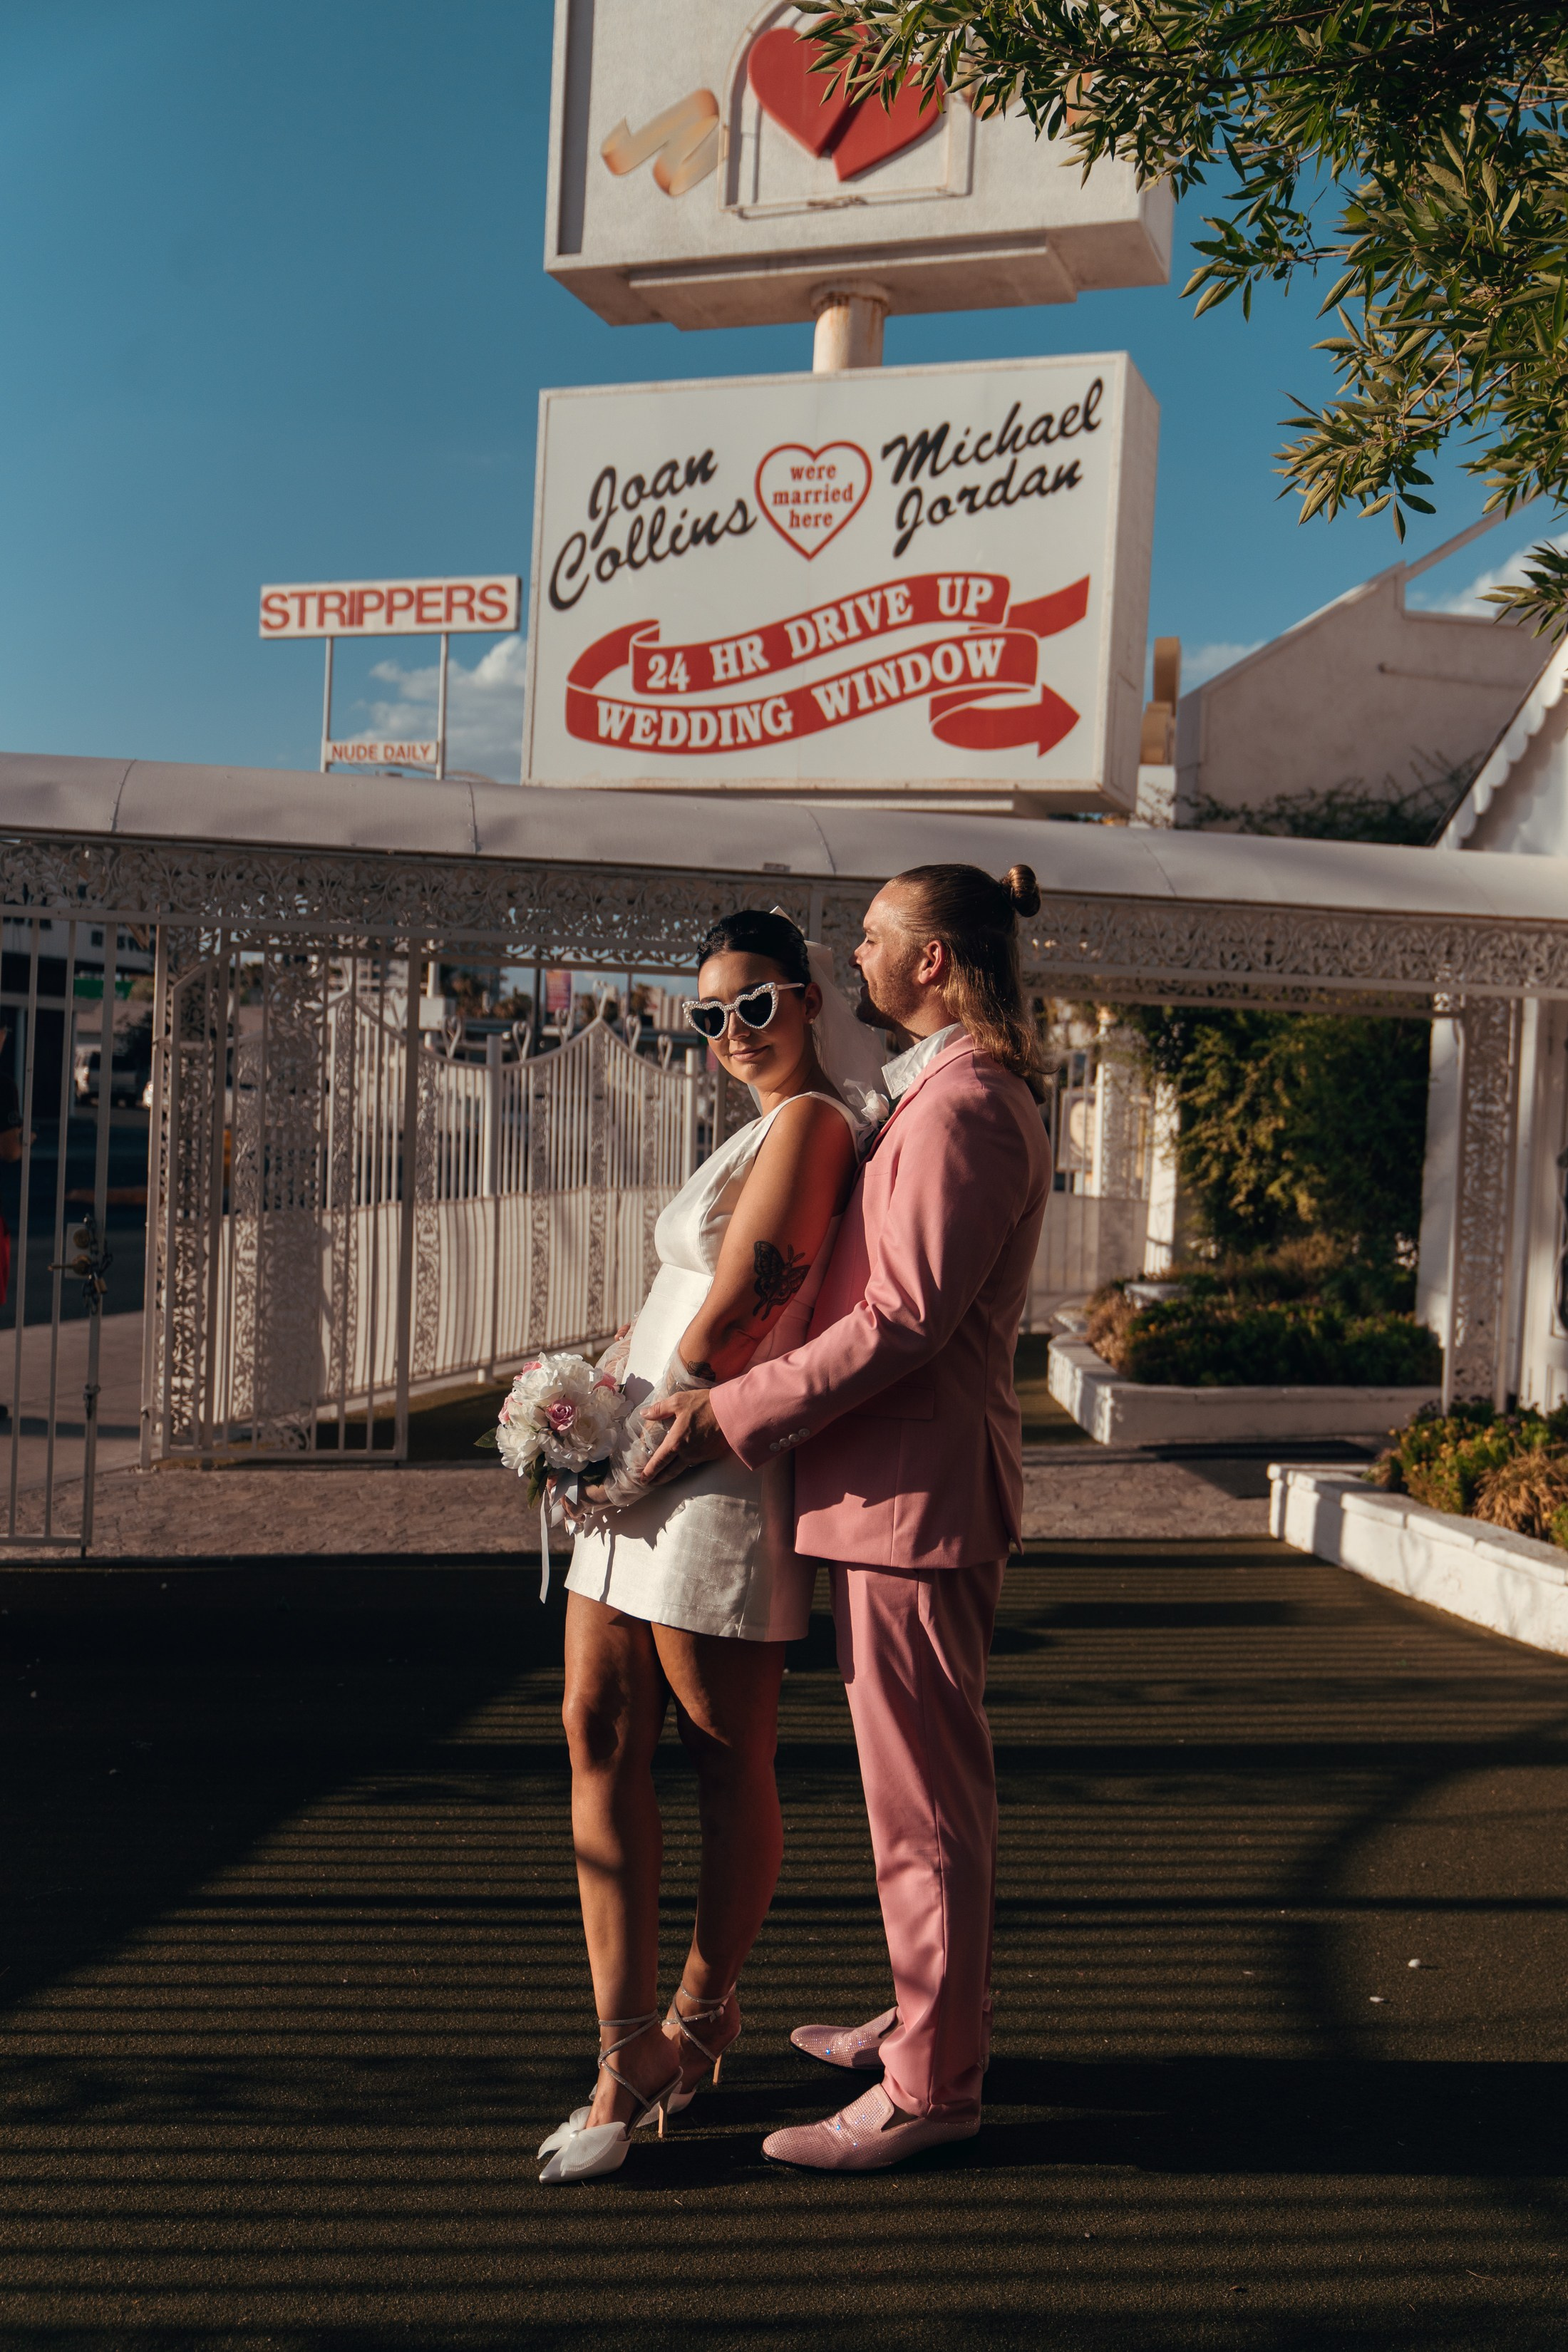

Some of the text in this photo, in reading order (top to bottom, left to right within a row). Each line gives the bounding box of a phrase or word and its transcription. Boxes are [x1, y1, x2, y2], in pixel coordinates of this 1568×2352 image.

[790, 465, 837, 481] were
[881, 378, 1103, 485] Michael
[588, 448, 717, 551] Joan
[772, 482, 855, 506] married
[789, 509, 833, 529] here
[893, 458, 1083, 558] Jordan
[548, 497, 758, 612] Collins
[261, 583, 509, 631] STRIPPERS
[646, 577, 994, 692] 24 HR DRIVE UP
[597, 637, 1006, 748] WEDDING WINDOW
[331, 743, 431, 763] NUDE DAILY
